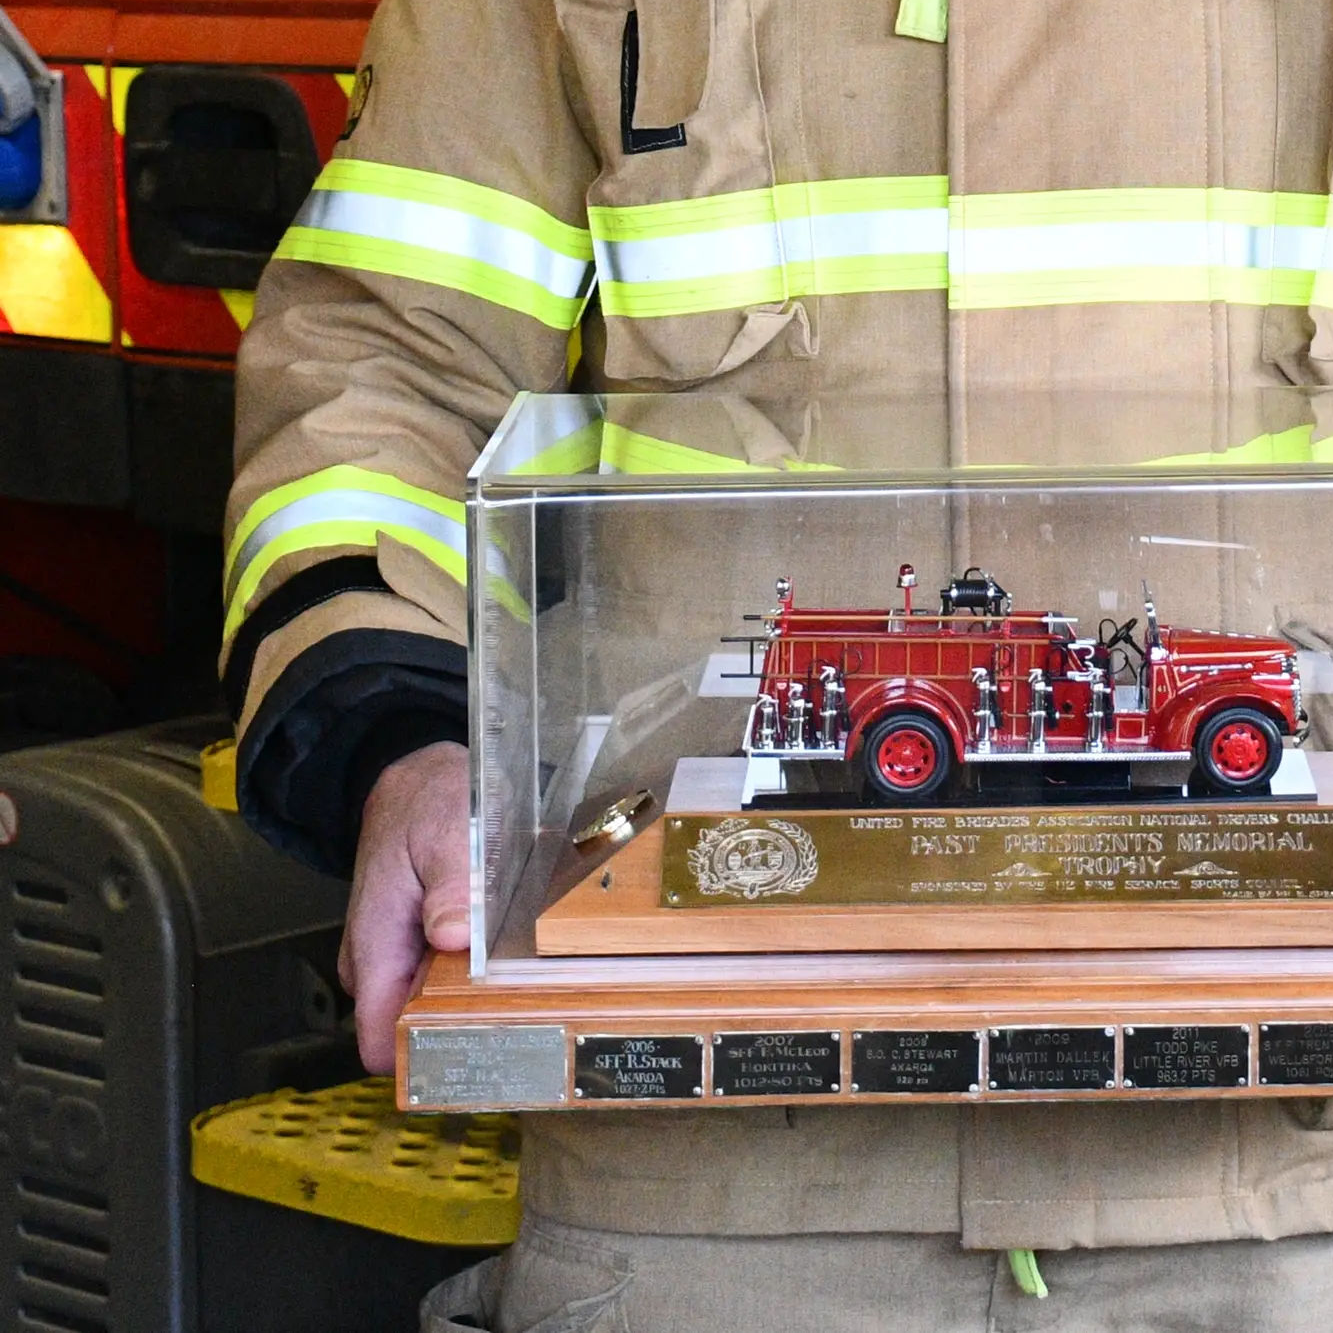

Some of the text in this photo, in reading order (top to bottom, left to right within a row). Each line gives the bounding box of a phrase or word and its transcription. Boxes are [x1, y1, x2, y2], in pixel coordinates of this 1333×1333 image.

[850, 817, 904, 829] UNITED
[911, 817, 947, 829] FIRE
[955, 816, 1030, 828] BRIGADES
[1036, 814, 1133, 827] ASSOCIATION
[1140, 814, 1211, 826] NATIONAL
[1218, 813, 1279, 825] DRIVERS
[911, 834, 980, 855] PAST
[1177, 831, 1314, 852] MEMORIAL
[1058, 855, 1167, 876] TROPHY
[1190, 878, 1240, 889] SPORTS
[1172, 1028, 1199, 1040] 2011
[755, 1035, 795, 1047] 2007
[1155, 1041, 1189, 1054] TODD
[903, 1048, 959, 1060] STEWART
[995, 1051, 1048, 1064] MARTIN
[741, 1061, 813, 1073] HOKITIKA
[1133, 1054, 1240, 1069] LITTLE RIVER VFB
[614, 1069, 665, 1083] AKAROA
[1072, 1069, 1101, 1081] VFB
[1192, 1069, 1216, 1082] PTS
